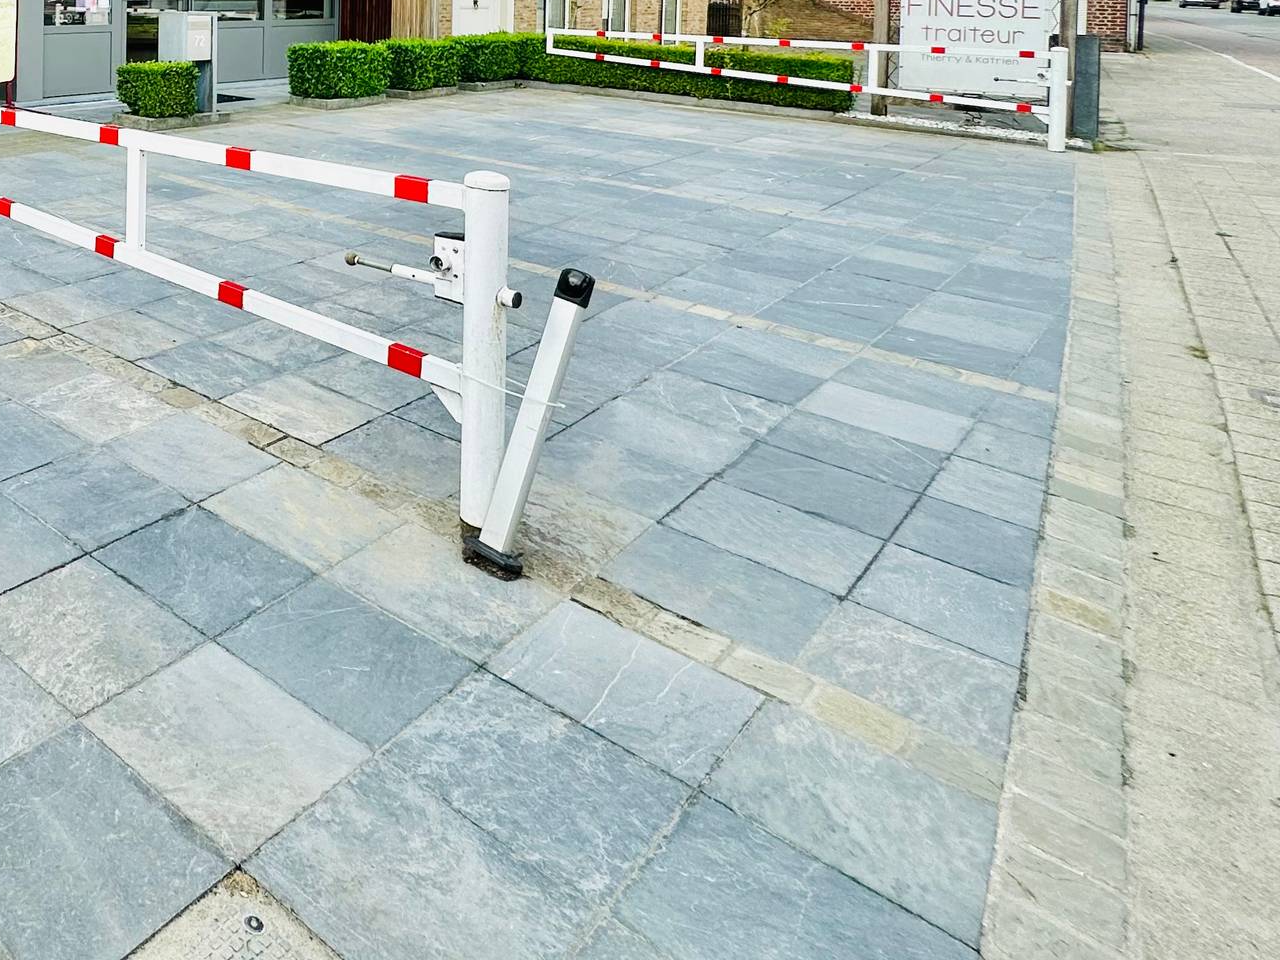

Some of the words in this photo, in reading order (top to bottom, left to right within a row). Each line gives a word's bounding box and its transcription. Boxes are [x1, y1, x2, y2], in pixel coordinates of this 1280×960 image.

[921, 24, 1025, 44] traiteur
[921, 53, 962, 63] Thierry
[965, 55, 972, 63] &
[975, 56, 1020, 65] Katrien
